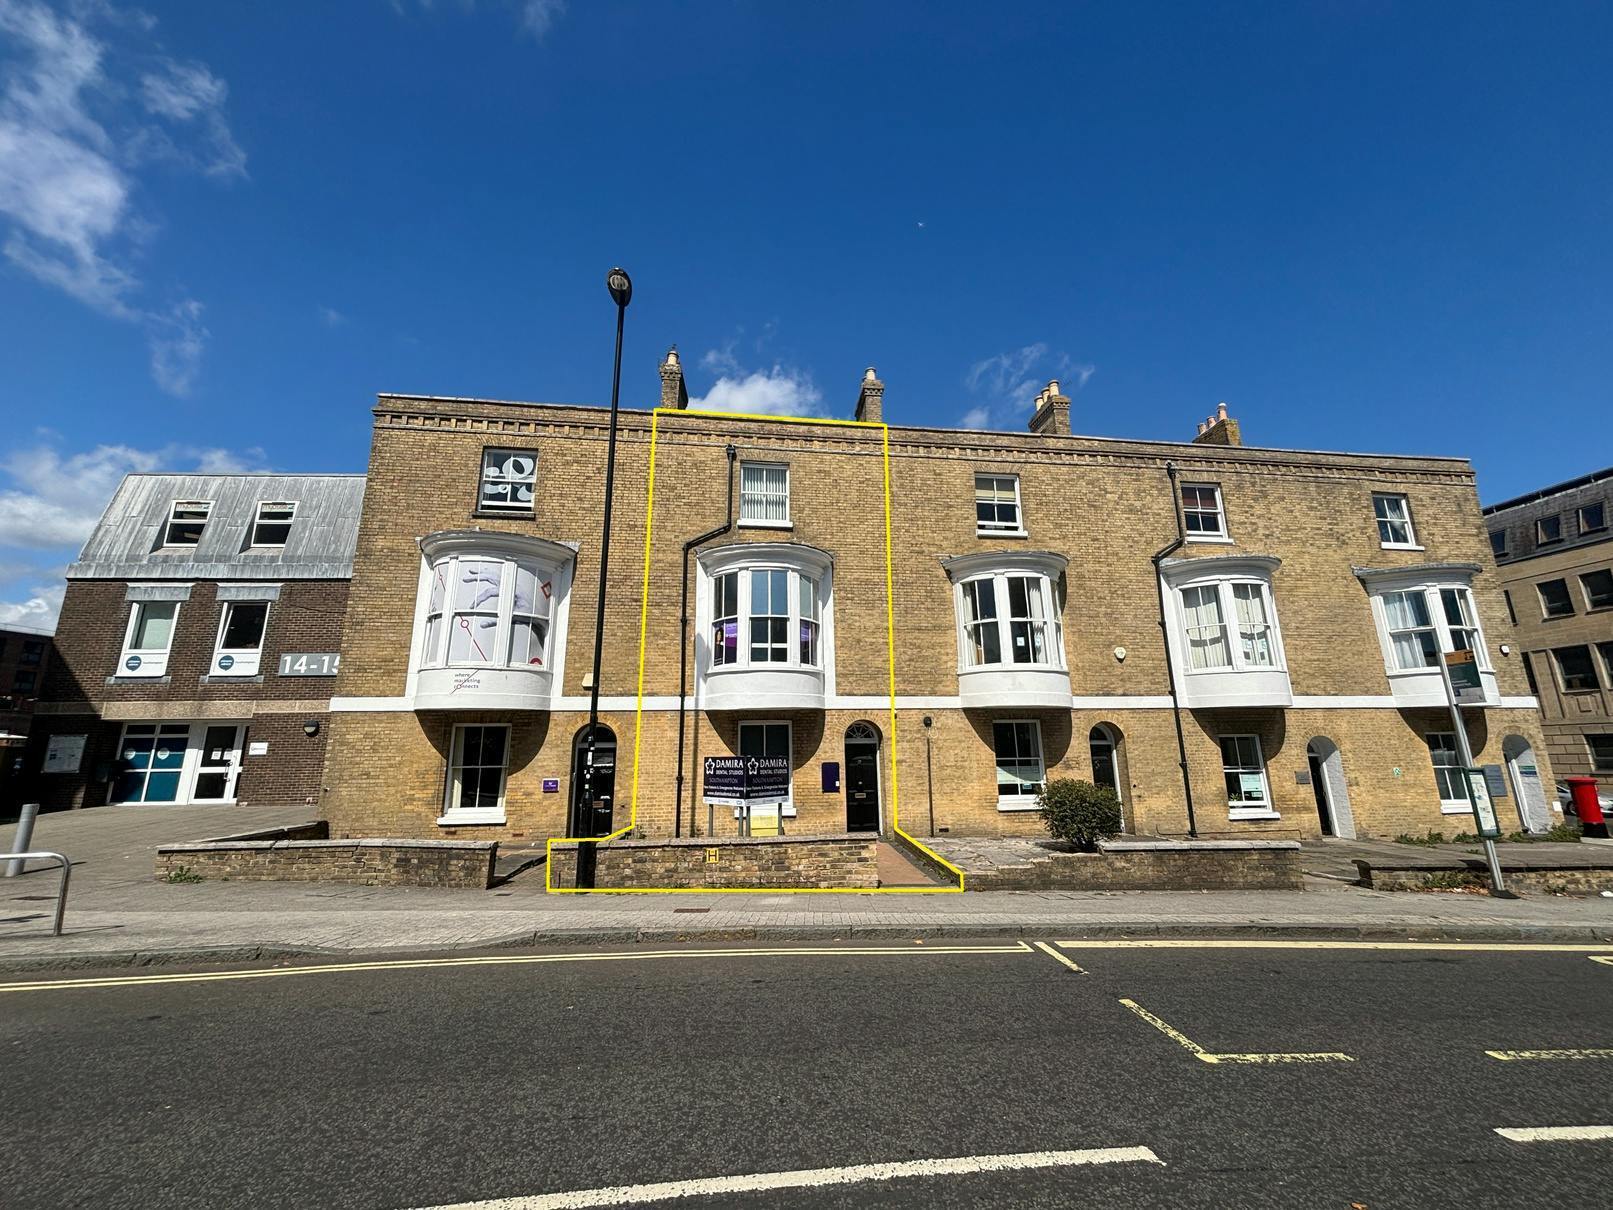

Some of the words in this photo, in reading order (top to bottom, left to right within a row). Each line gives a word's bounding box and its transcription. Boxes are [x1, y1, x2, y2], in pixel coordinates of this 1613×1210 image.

[283, 655, 340, 674] 14-15
[715, 759, 744, 769] DAMIRA
[759, 758, 788, 768] DAMIRA
[708, 849, 718, 862] H
